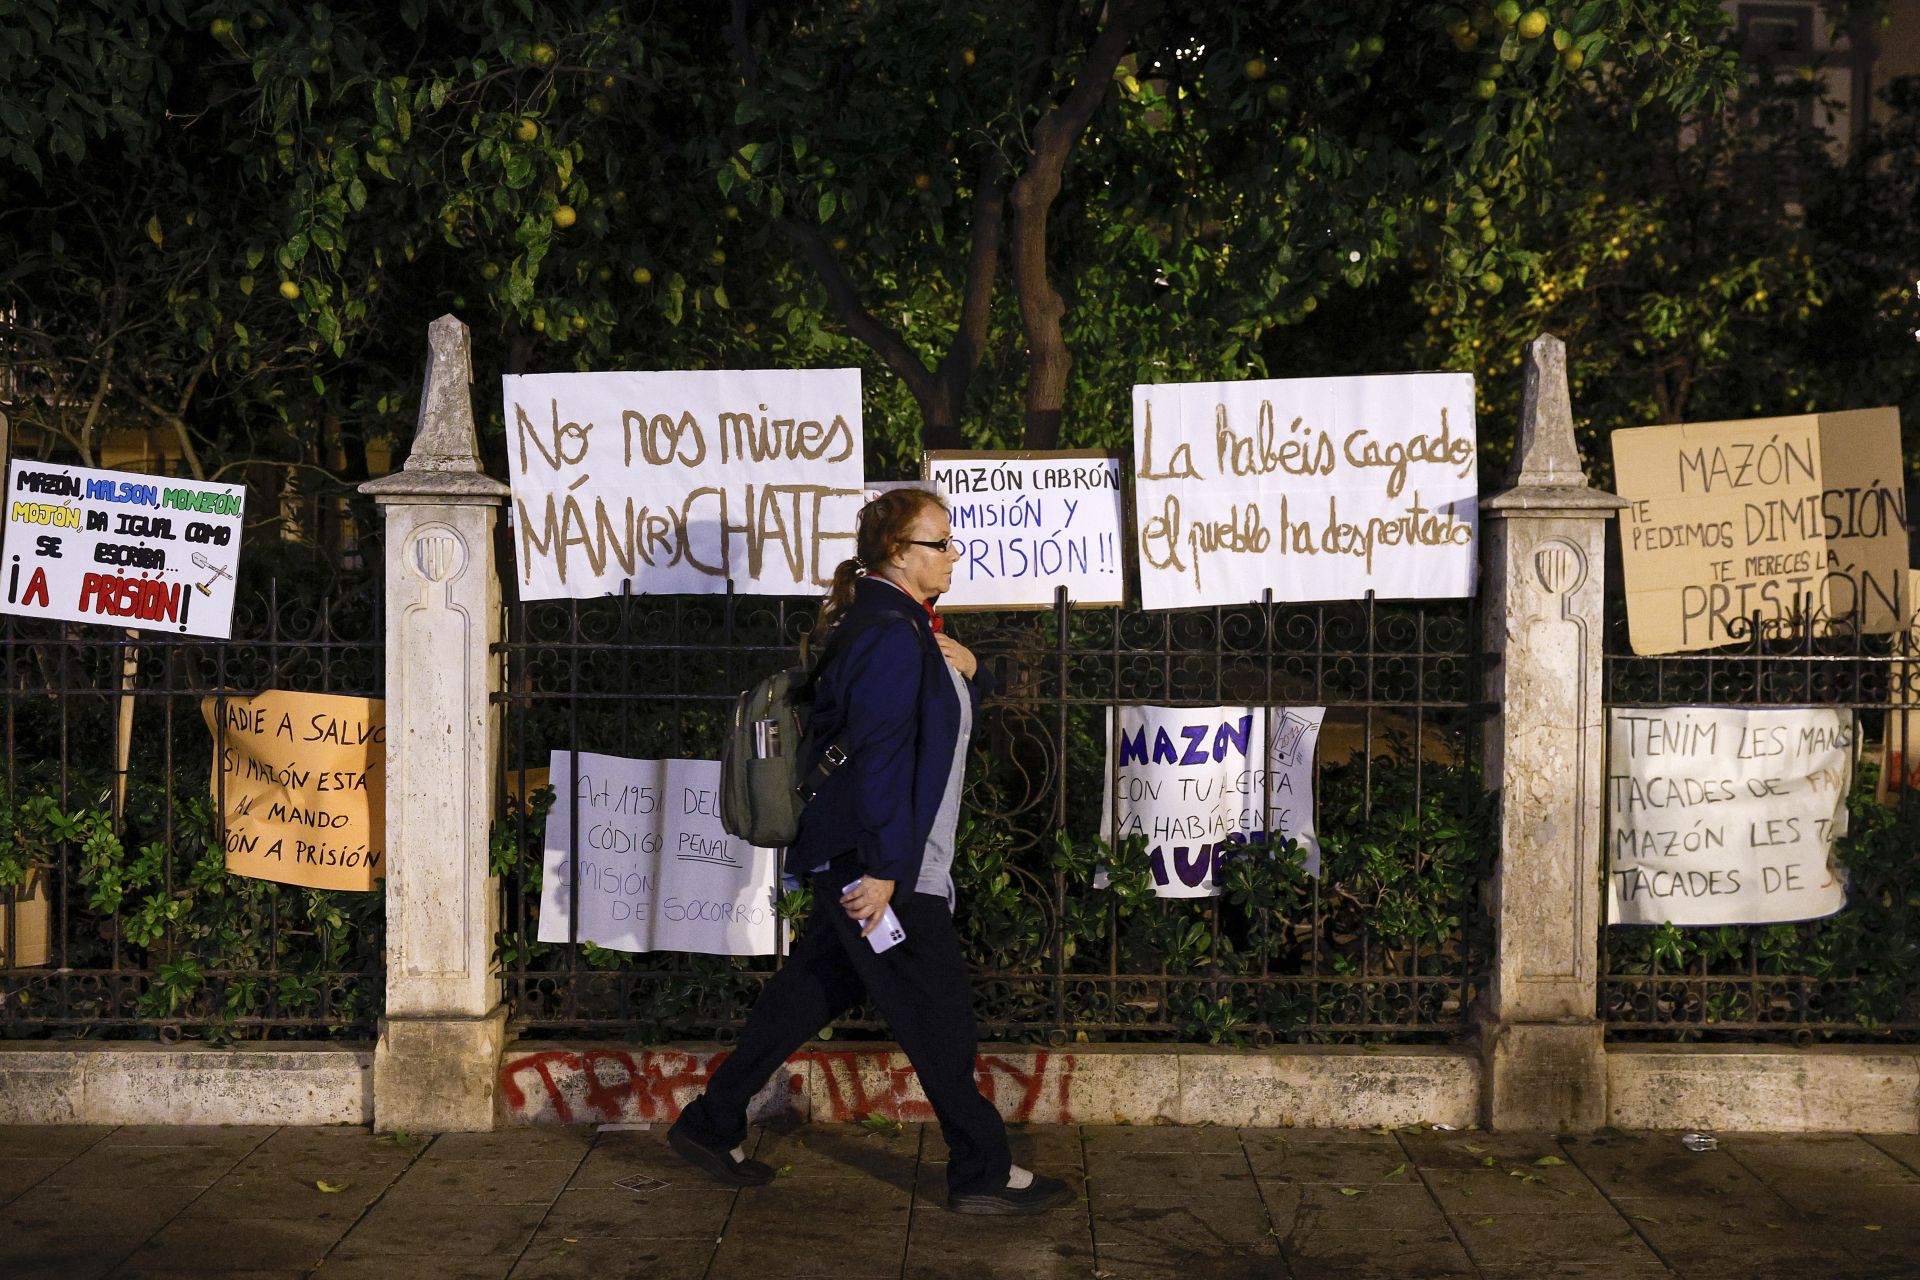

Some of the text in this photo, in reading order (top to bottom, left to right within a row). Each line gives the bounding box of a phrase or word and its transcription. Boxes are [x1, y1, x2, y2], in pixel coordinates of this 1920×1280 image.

[514, 398, 853, 475] No nos mires
[1137, 399, 1206, 480] La
[1215, 399, 1335, 476] habéis
[936, 462, 1120, 494] MAZÓN CABRÓN
[1678, 434, 1816, 493] MAZÓN
[17, 469, 243, 518] MAZÓN, MALSON, MONZÓN,
[1632, 500, 1652, 523] TE
[12, 500, 231, 546] MOJÓN, DA IGUAL COMO
[1063, 498, 1079, 528] Y
[1632, 479, 1910, 551] PEDIMOS DIMISIÓN
[35, 535, 63, 559] SE
[1142, 489, 1473, 594] el pueblo ha despertado
[1711, 549, 1840, 582] TE MERECES LA
[276, 712, 294, 743] A
[1119, 714, 1254, 767] MAZON
[1617, 714, 1851, 759] TENIM LES MANS
[246, 754, 310, 791] MAZÓN
[316, 762, 376, 792] ESTÁ
[1117, 775, 1163, 802] CON
[1178, 778, 1214, 802] TU
[234, 794, 349, 829] AL MANDO
[1610, 775, 1735, 814] TACADES
[1747, 777, 1791, 798] DE
[588, 821, 736, 860] CÓDIGO PENAL
[1116, 811, 1145, 841] YA
[1153, 804, 1226, 842] HABÍA
[1616, 819, 1724, 860] MAZÓN
[1750, 817, 1801, 847] LES
[264, 838, 283, 861] A
[296, 842, 382, 868] PRISIÓN
[1613, 867, 1741, 901] TACADES
[1763, 864, 1805, 894] DE
[612, 897, 764, 925] DE SOCORRO
